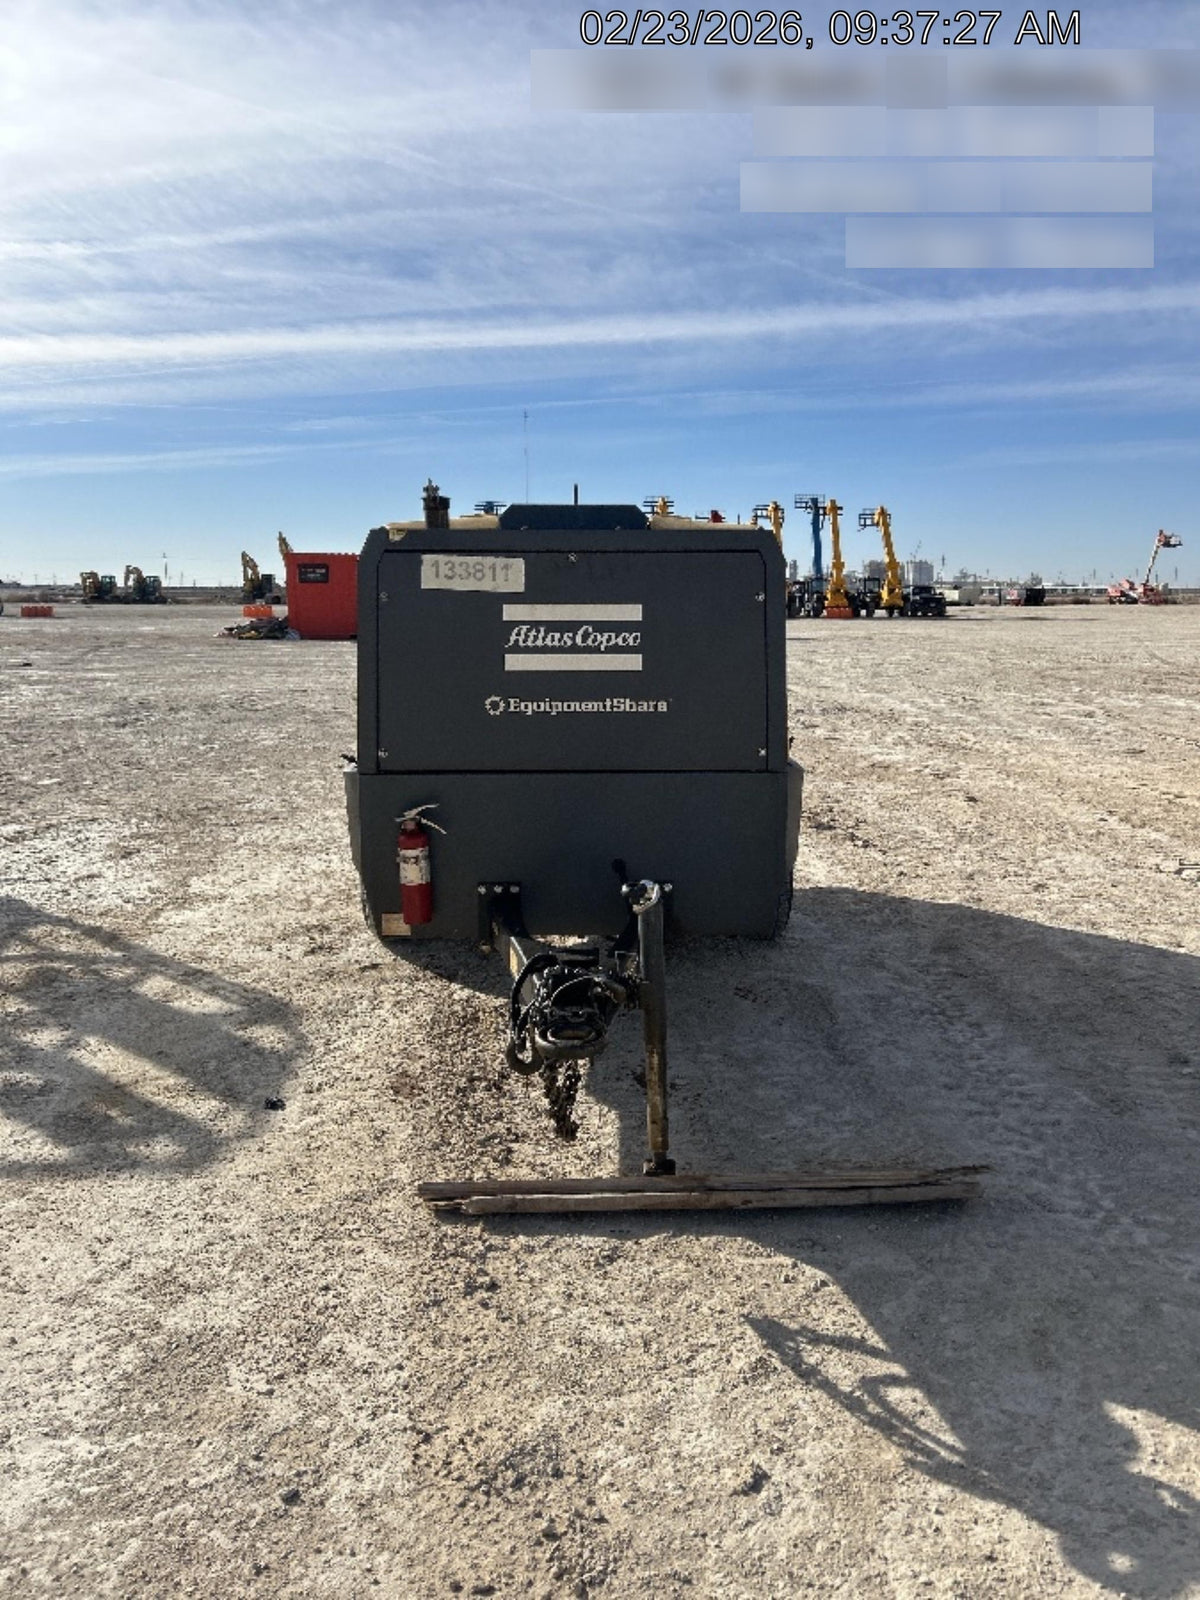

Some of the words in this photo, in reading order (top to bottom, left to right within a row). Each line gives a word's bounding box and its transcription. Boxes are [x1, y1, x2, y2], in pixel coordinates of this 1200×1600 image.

[431, 560, 512, 582] 133811
[504, 625, 573, 647] Atlas
[575, 625, 641, 651] Copco
[508, 698, 668, 715] EquipmentShare
